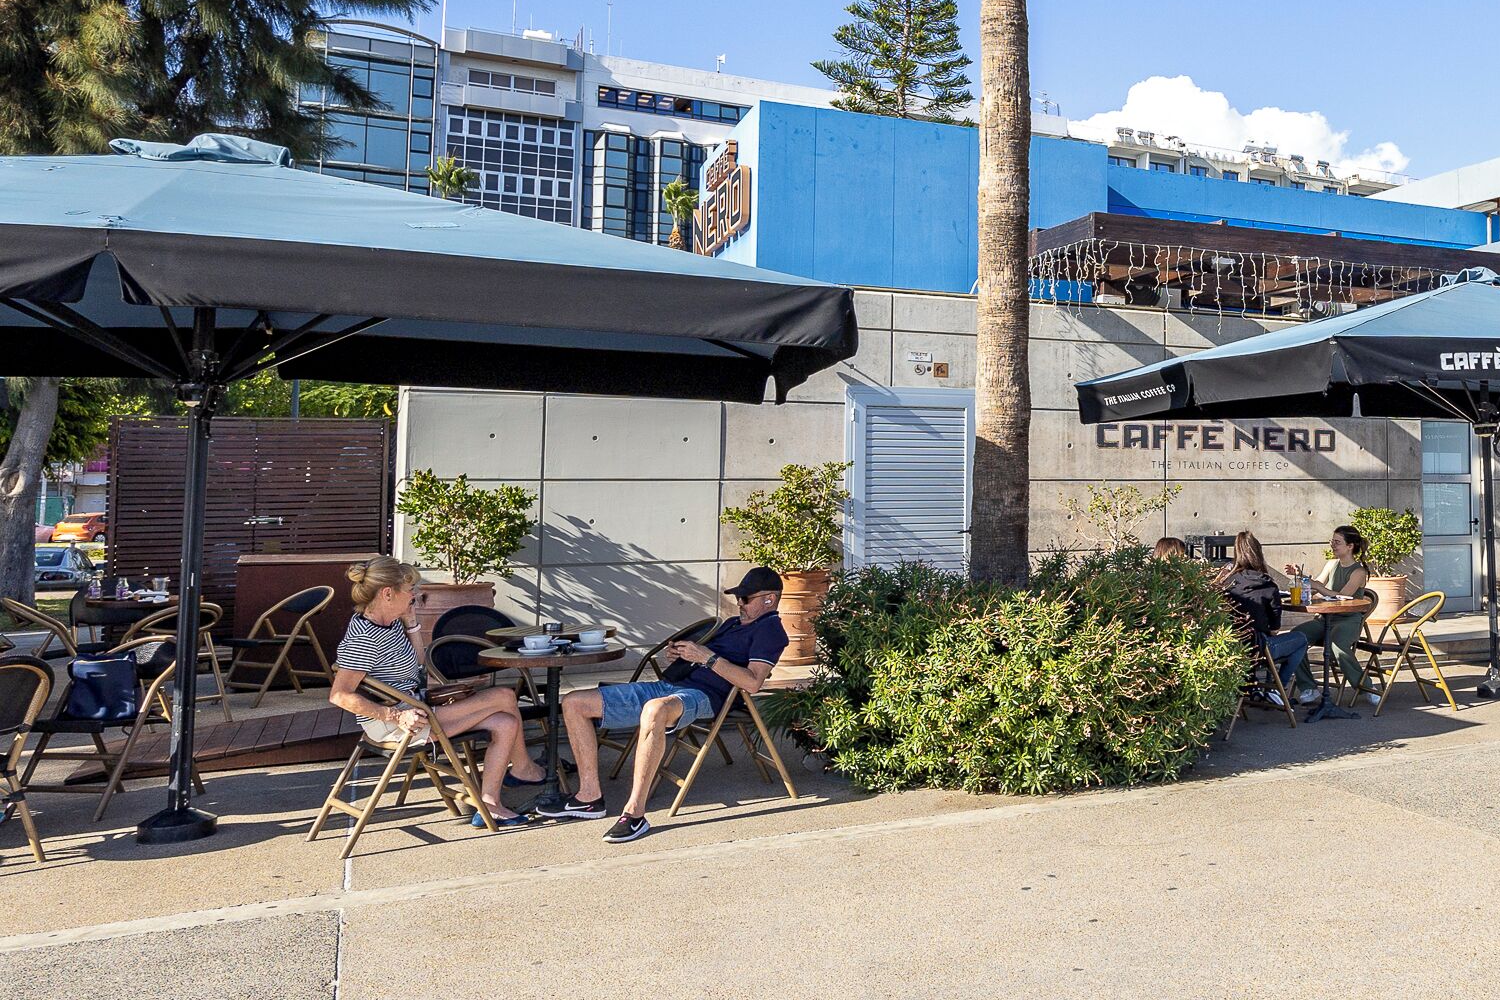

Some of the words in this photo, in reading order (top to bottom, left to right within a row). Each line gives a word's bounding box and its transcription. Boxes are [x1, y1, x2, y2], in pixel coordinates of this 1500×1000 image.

[692, 165, 751, 256] NERO
[1103, 395, 1118, 407] THE
[1117, 391, 1142, 404] ITALIAN
[1140, 385, 1167, 400] COFFEE
[1233, 426, 1337, 453] NERO
[1152, 460, 1172, 470] THE
[1178, 460, 1222, 470] ITALIAN
[1228, 461, 1270, 470] COFFEE
